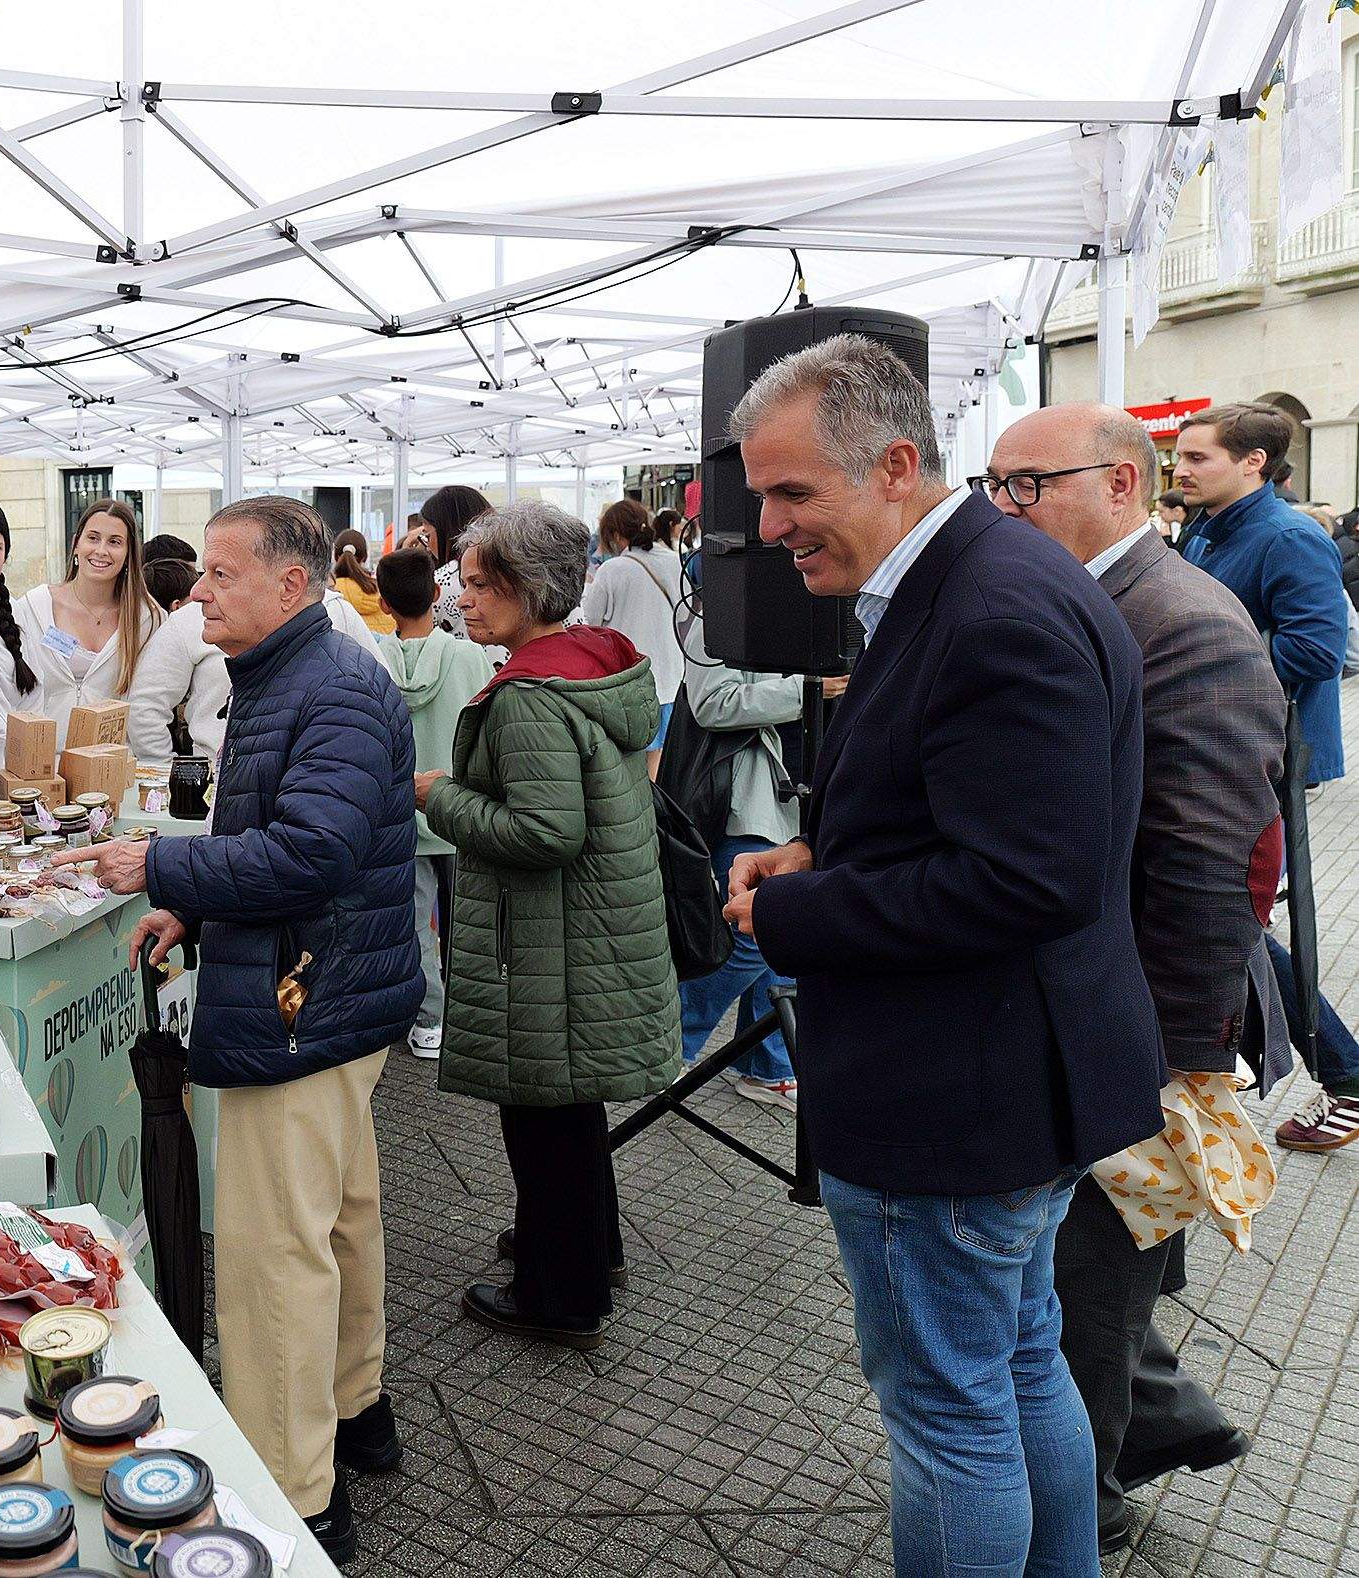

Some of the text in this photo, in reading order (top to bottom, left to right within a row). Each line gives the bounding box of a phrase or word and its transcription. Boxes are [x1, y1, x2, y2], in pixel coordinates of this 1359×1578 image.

[44, 967, 136, 1063] DEPOEMPRENDE
[100, 1002, 137, 1061] NA ESO
